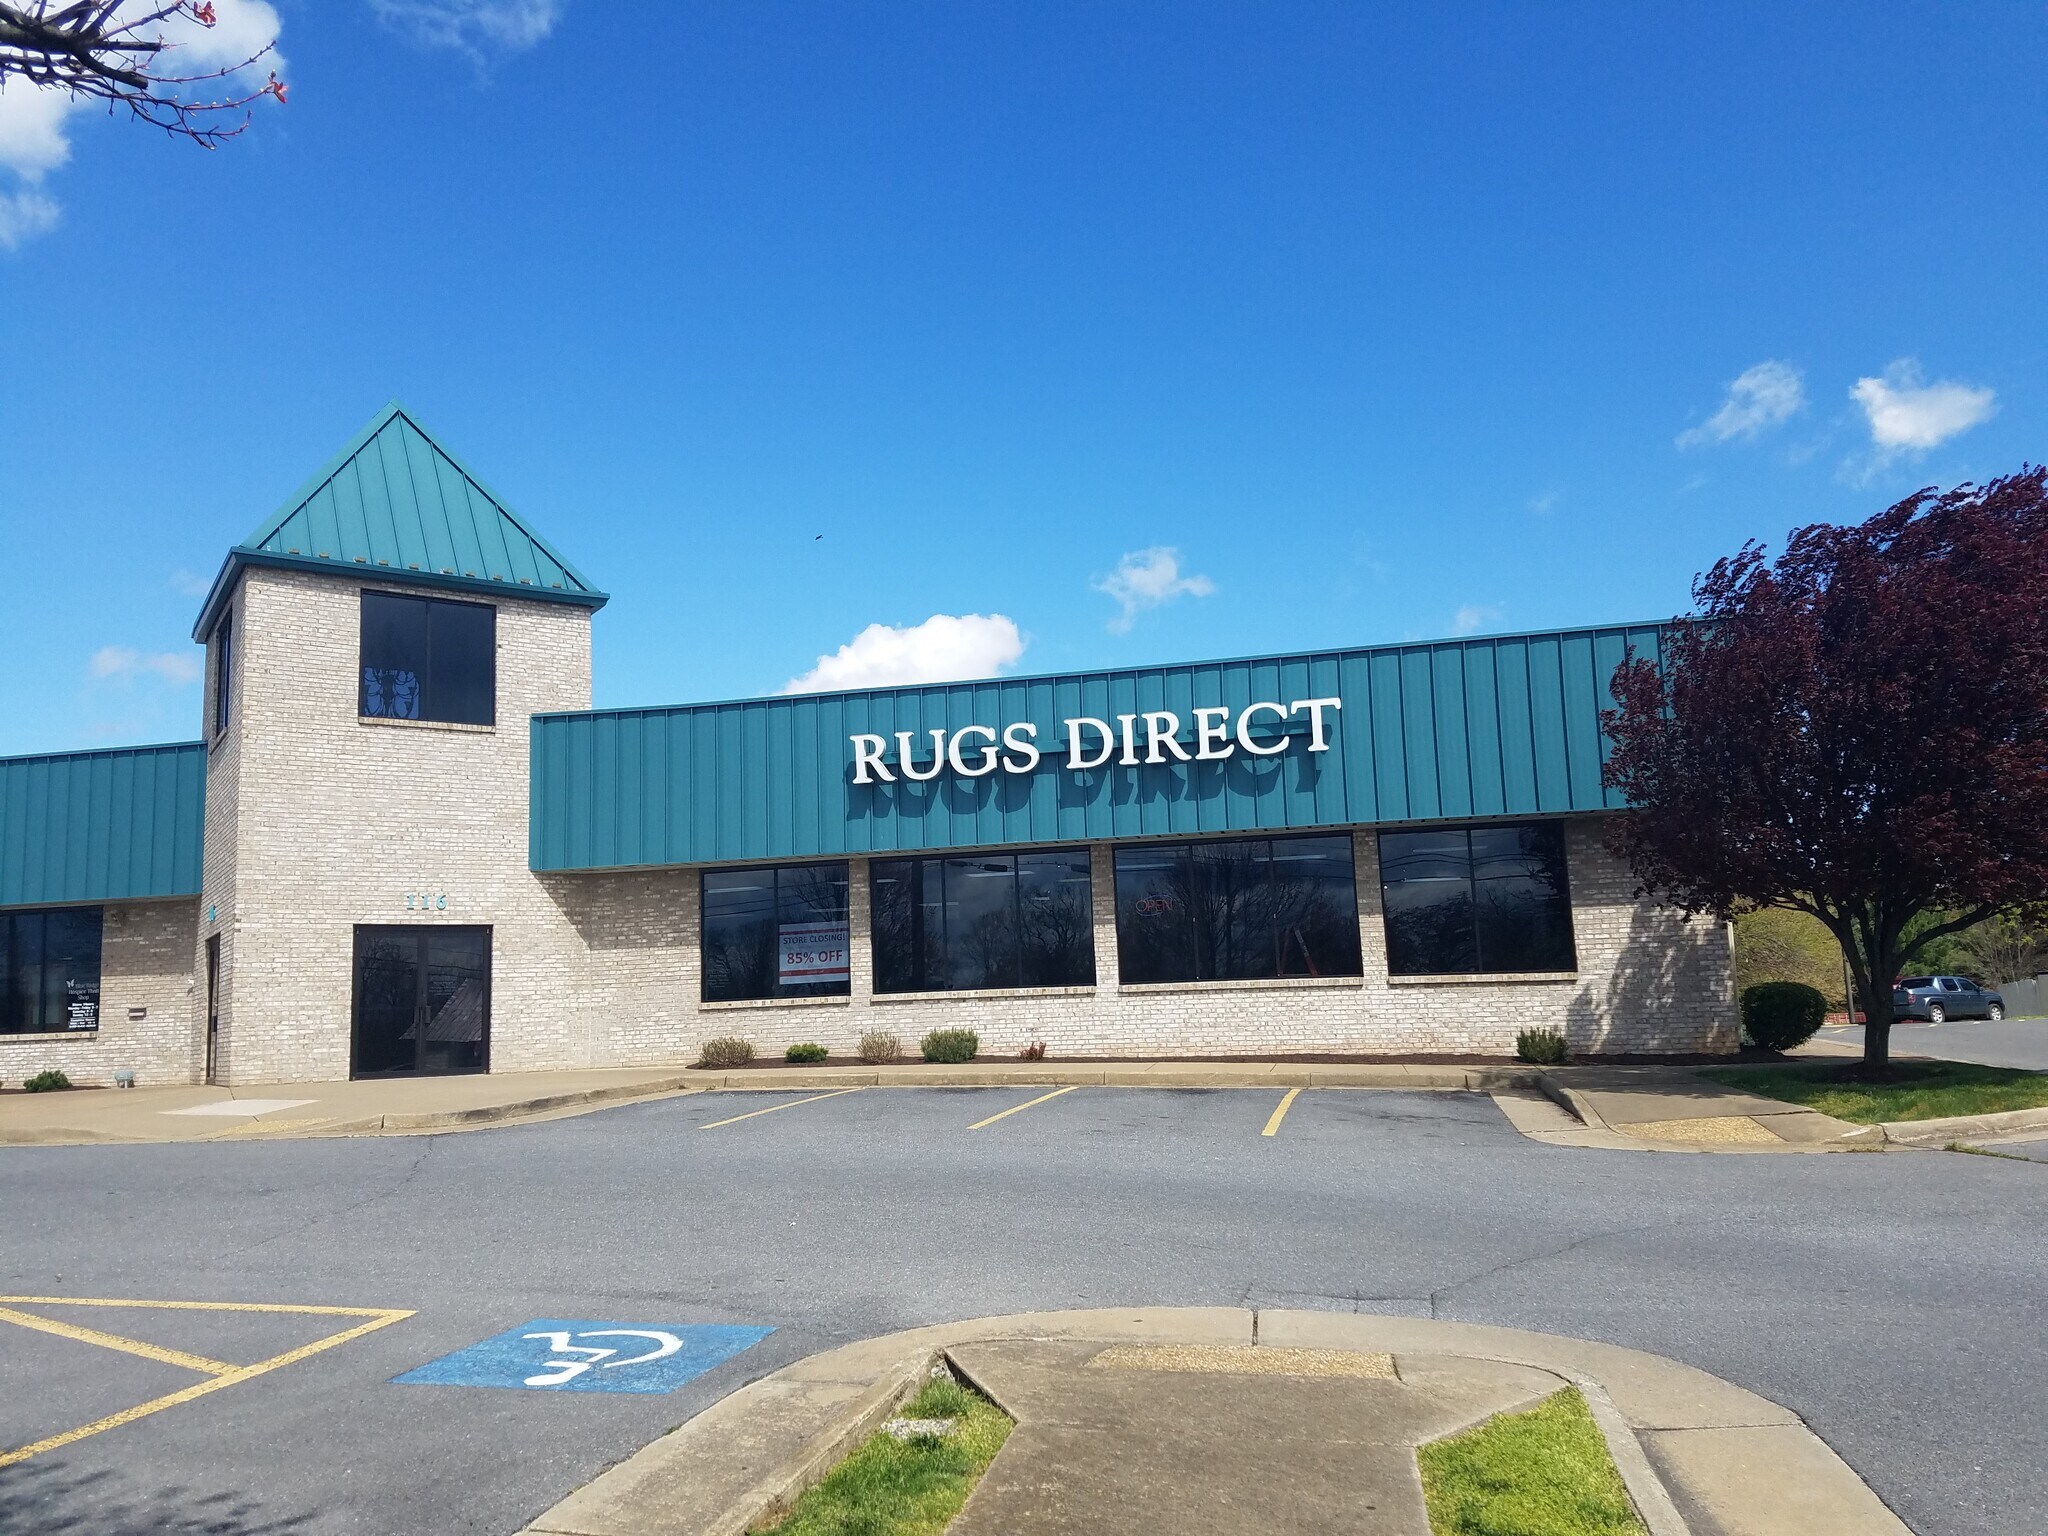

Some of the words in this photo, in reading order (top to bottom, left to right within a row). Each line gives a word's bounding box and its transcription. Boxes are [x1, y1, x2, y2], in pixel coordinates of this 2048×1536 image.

[849, 722, 1040, 784] RUGS
[1063, 697, 1342, 769] DIRECT
[406, 893, 447, 911] 116
[1136, 899, 1173, 912] OPEN
[783, 936, 807, 945] STORE
[809, 933, 846, 943] CLOSING!
[787, 951, 814, 965] 85%
[818, 949, 843, 962] OFF
